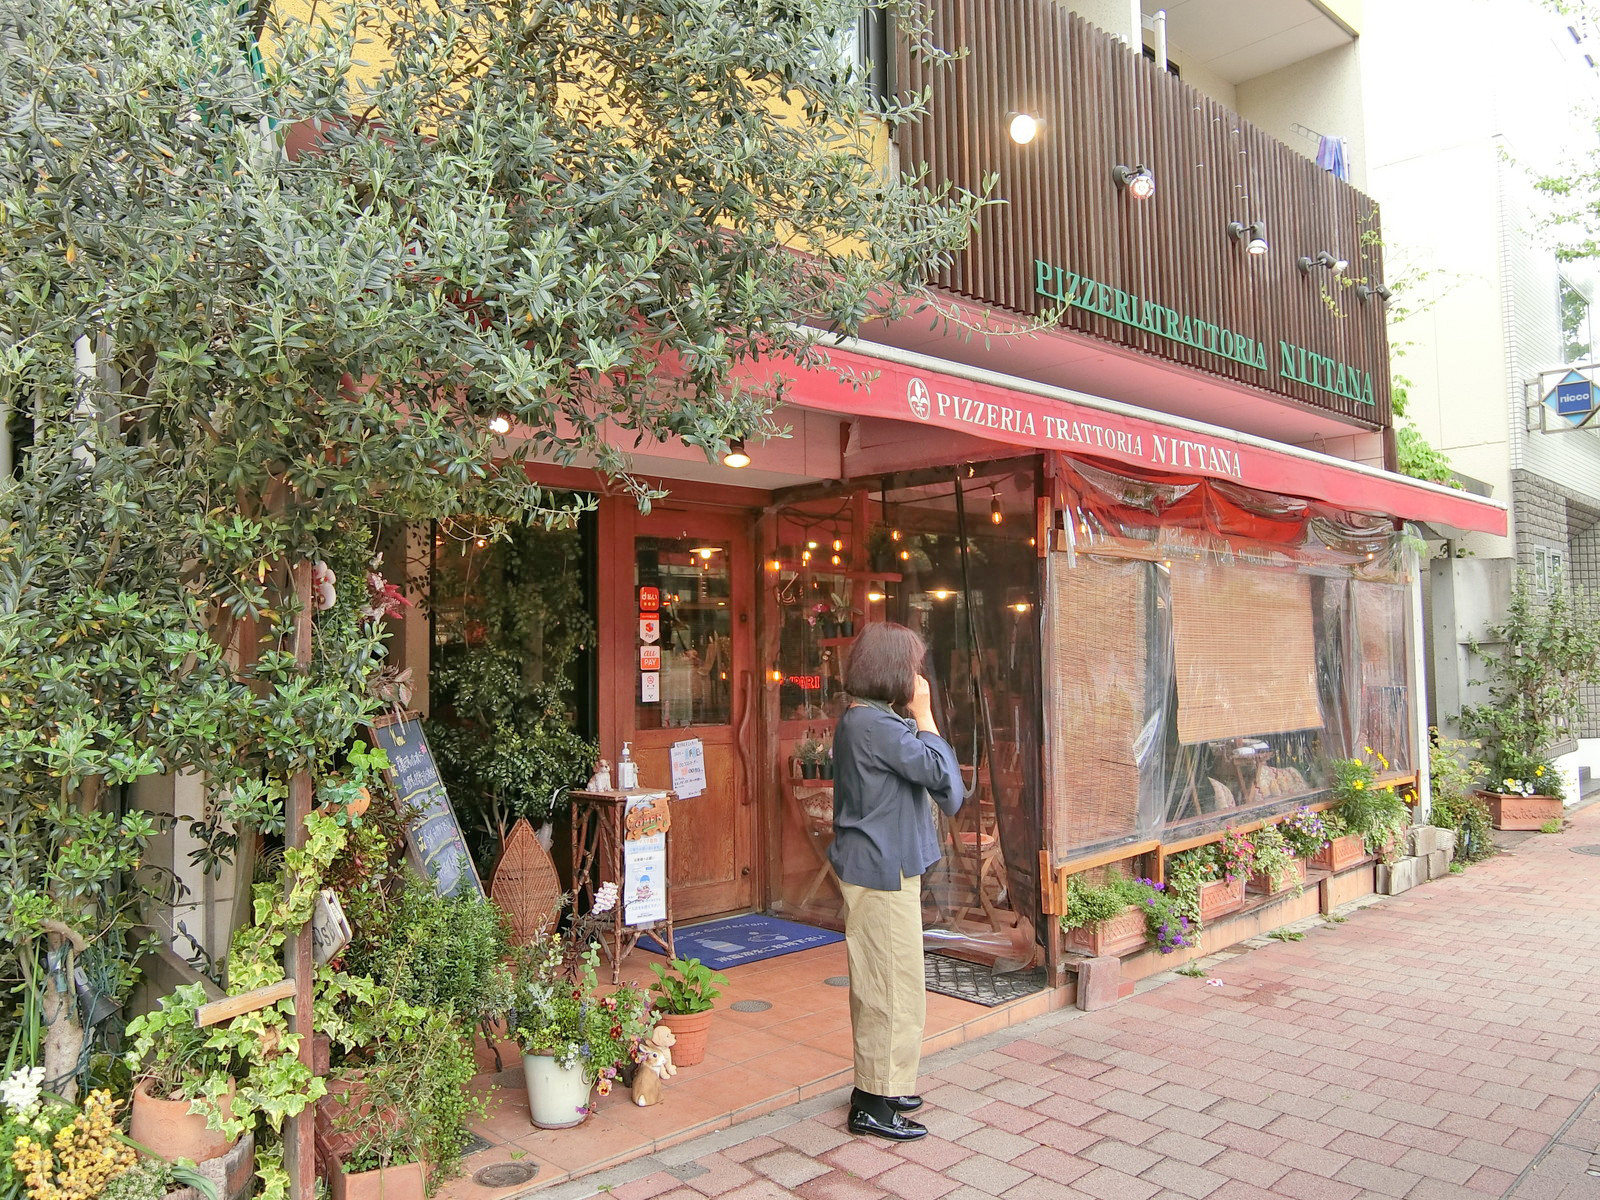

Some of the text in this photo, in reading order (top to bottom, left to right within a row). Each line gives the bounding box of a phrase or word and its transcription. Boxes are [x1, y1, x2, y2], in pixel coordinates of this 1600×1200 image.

[1279, 340, 1376, 406] NITTANA
[1560, 393, 1589, 402] nicco
[935, 391, 1243, 479] PIZZERIA TRATTORIA NITTANA
[644, 658, 657, 666] PAY
[635, 813, 663, 828] OPEN
